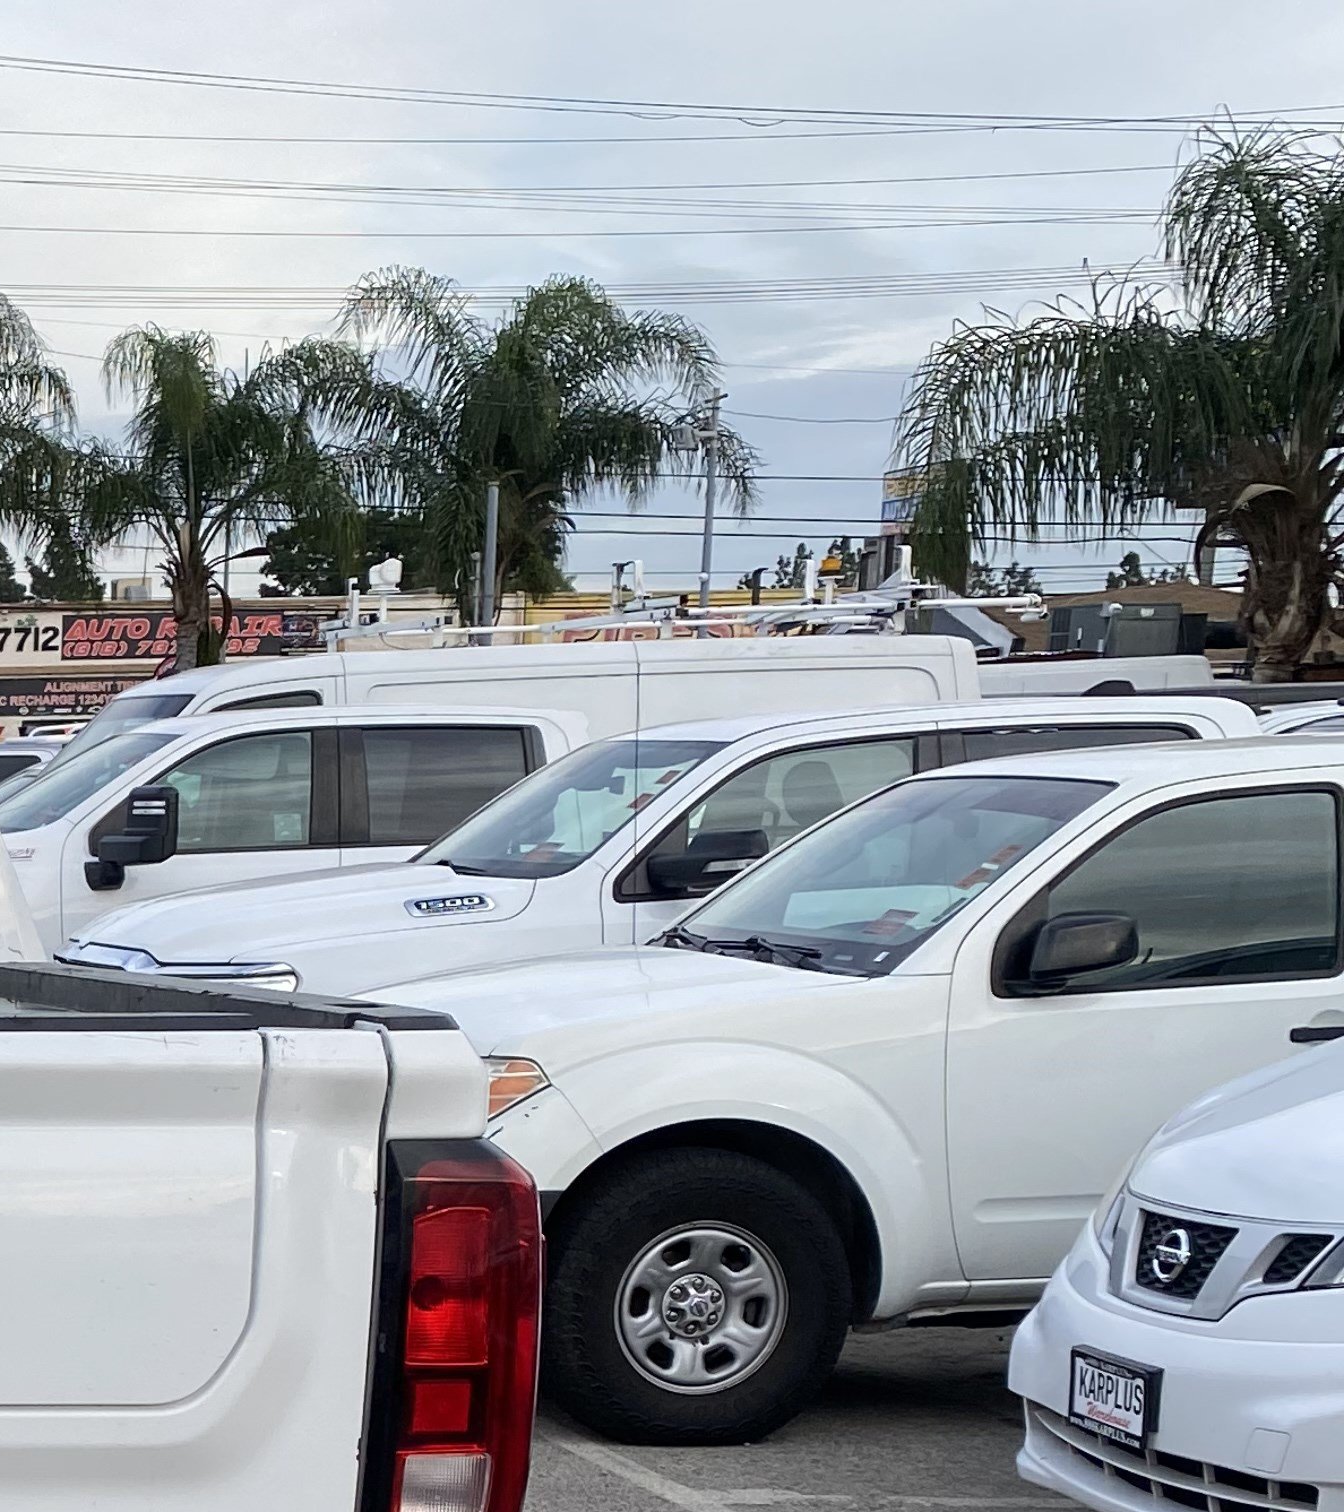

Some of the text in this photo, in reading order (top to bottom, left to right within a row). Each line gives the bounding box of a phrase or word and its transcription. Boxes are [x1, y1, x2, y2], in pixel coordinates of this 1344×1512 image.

[64, 617, 150, 640] AUTO
[156, 615, 283, 639] RPAIR
[63, 640, 129, 657] (818)
[44, 681, 112, 693] ALIGNMENT
[10, 694, 76, 707] RECHARGE
[419, 896, 480, 910] 1500
[1079, 1365, 1144, 1416] KARPLUS
